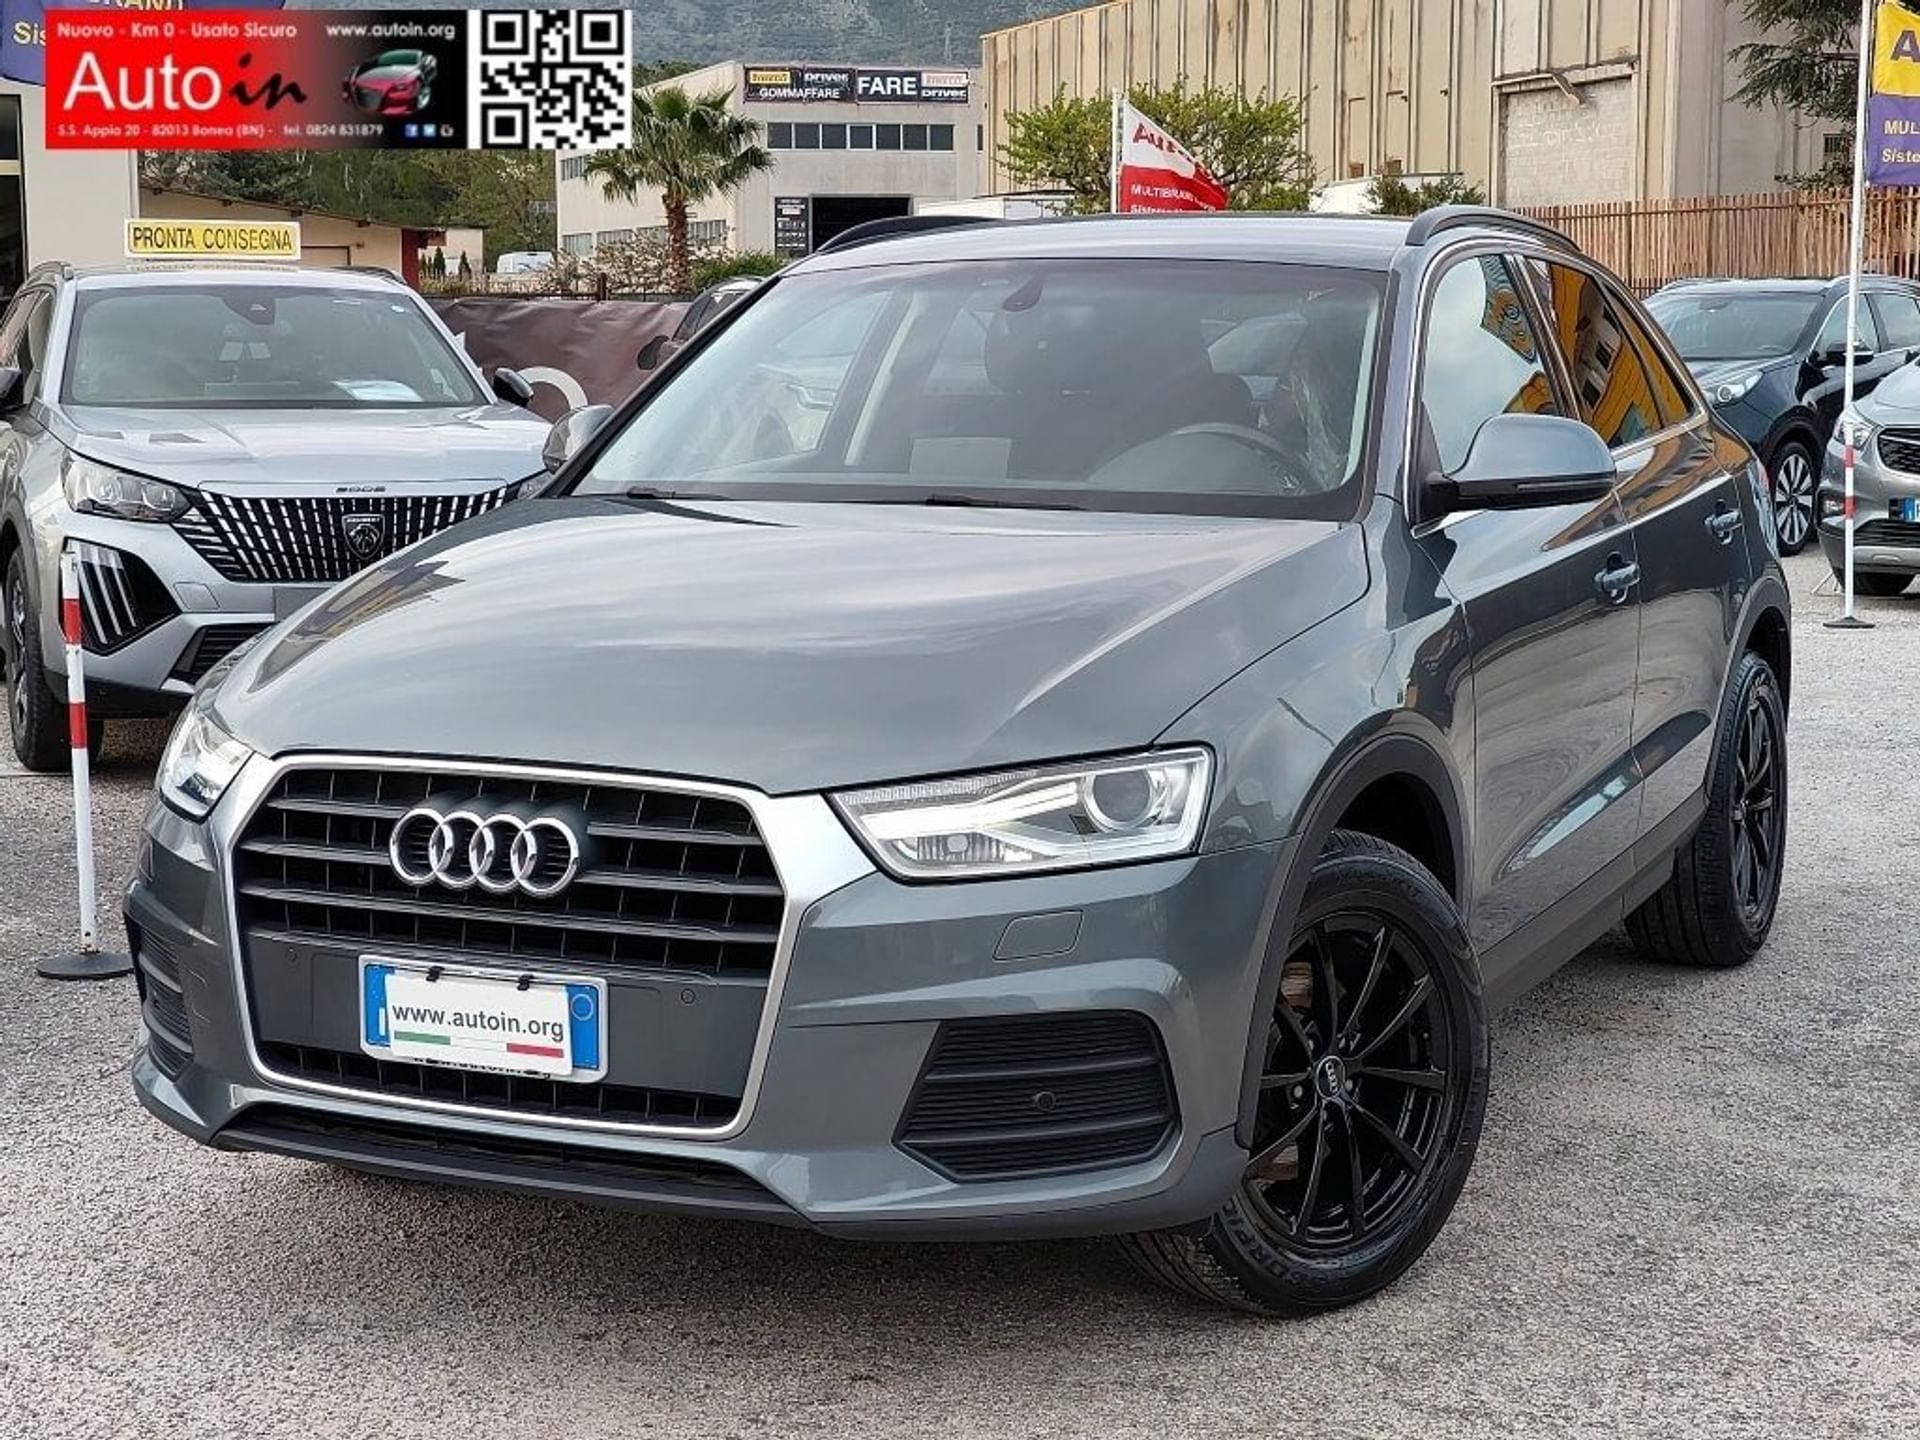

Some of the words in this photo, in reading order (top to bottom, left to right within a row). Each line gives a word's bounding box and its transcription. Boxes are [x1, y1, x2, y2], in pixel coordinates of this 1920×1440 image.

[759, 88, 840, 99] GOMMAFFARE
[858, 77, 917, 95] FARE
[133, 227, 195, 249] PRONTA
[203, 228, 292, 250] CONSEGNA
[392, 1004, 564, 1042] www.autoin.org
